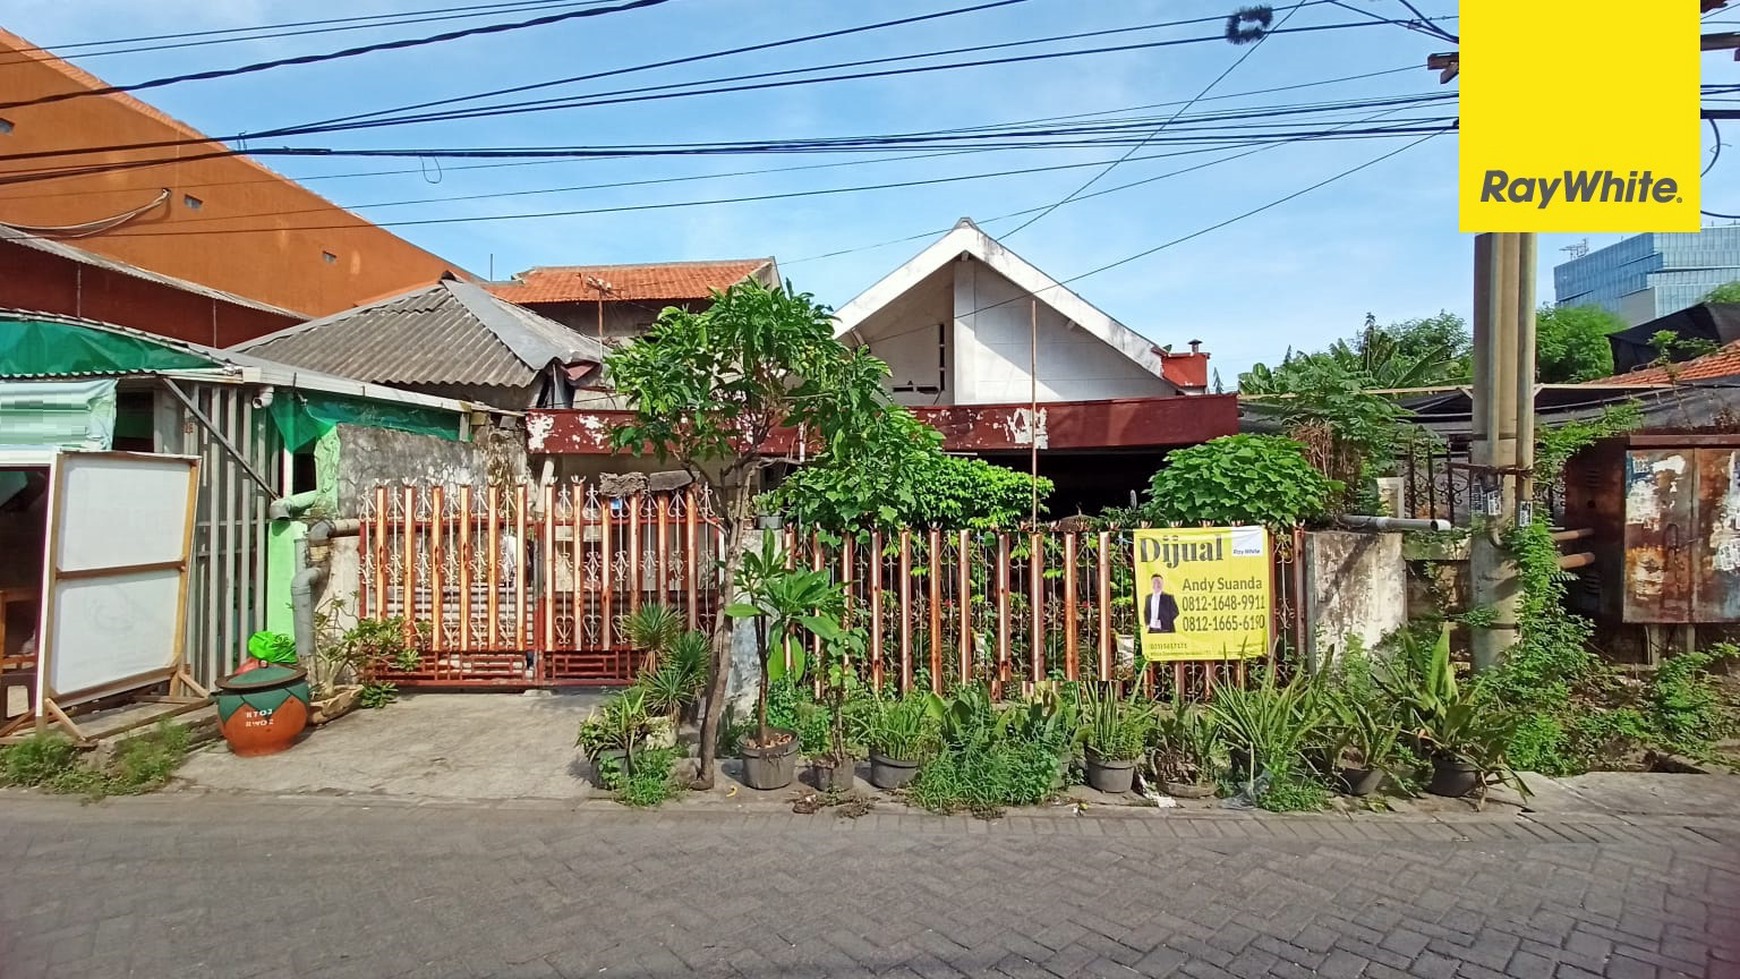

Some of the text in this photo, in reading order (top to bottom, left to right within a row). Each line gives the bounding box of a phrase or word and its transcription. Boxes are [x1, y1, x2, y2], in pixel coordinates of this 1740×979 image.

[1140, 535, 1224, 568] Dijual
[1182, 576, 1262, 593] Andy Suanda
[1182, 595, 1265, 611] 0812-1648-9911
